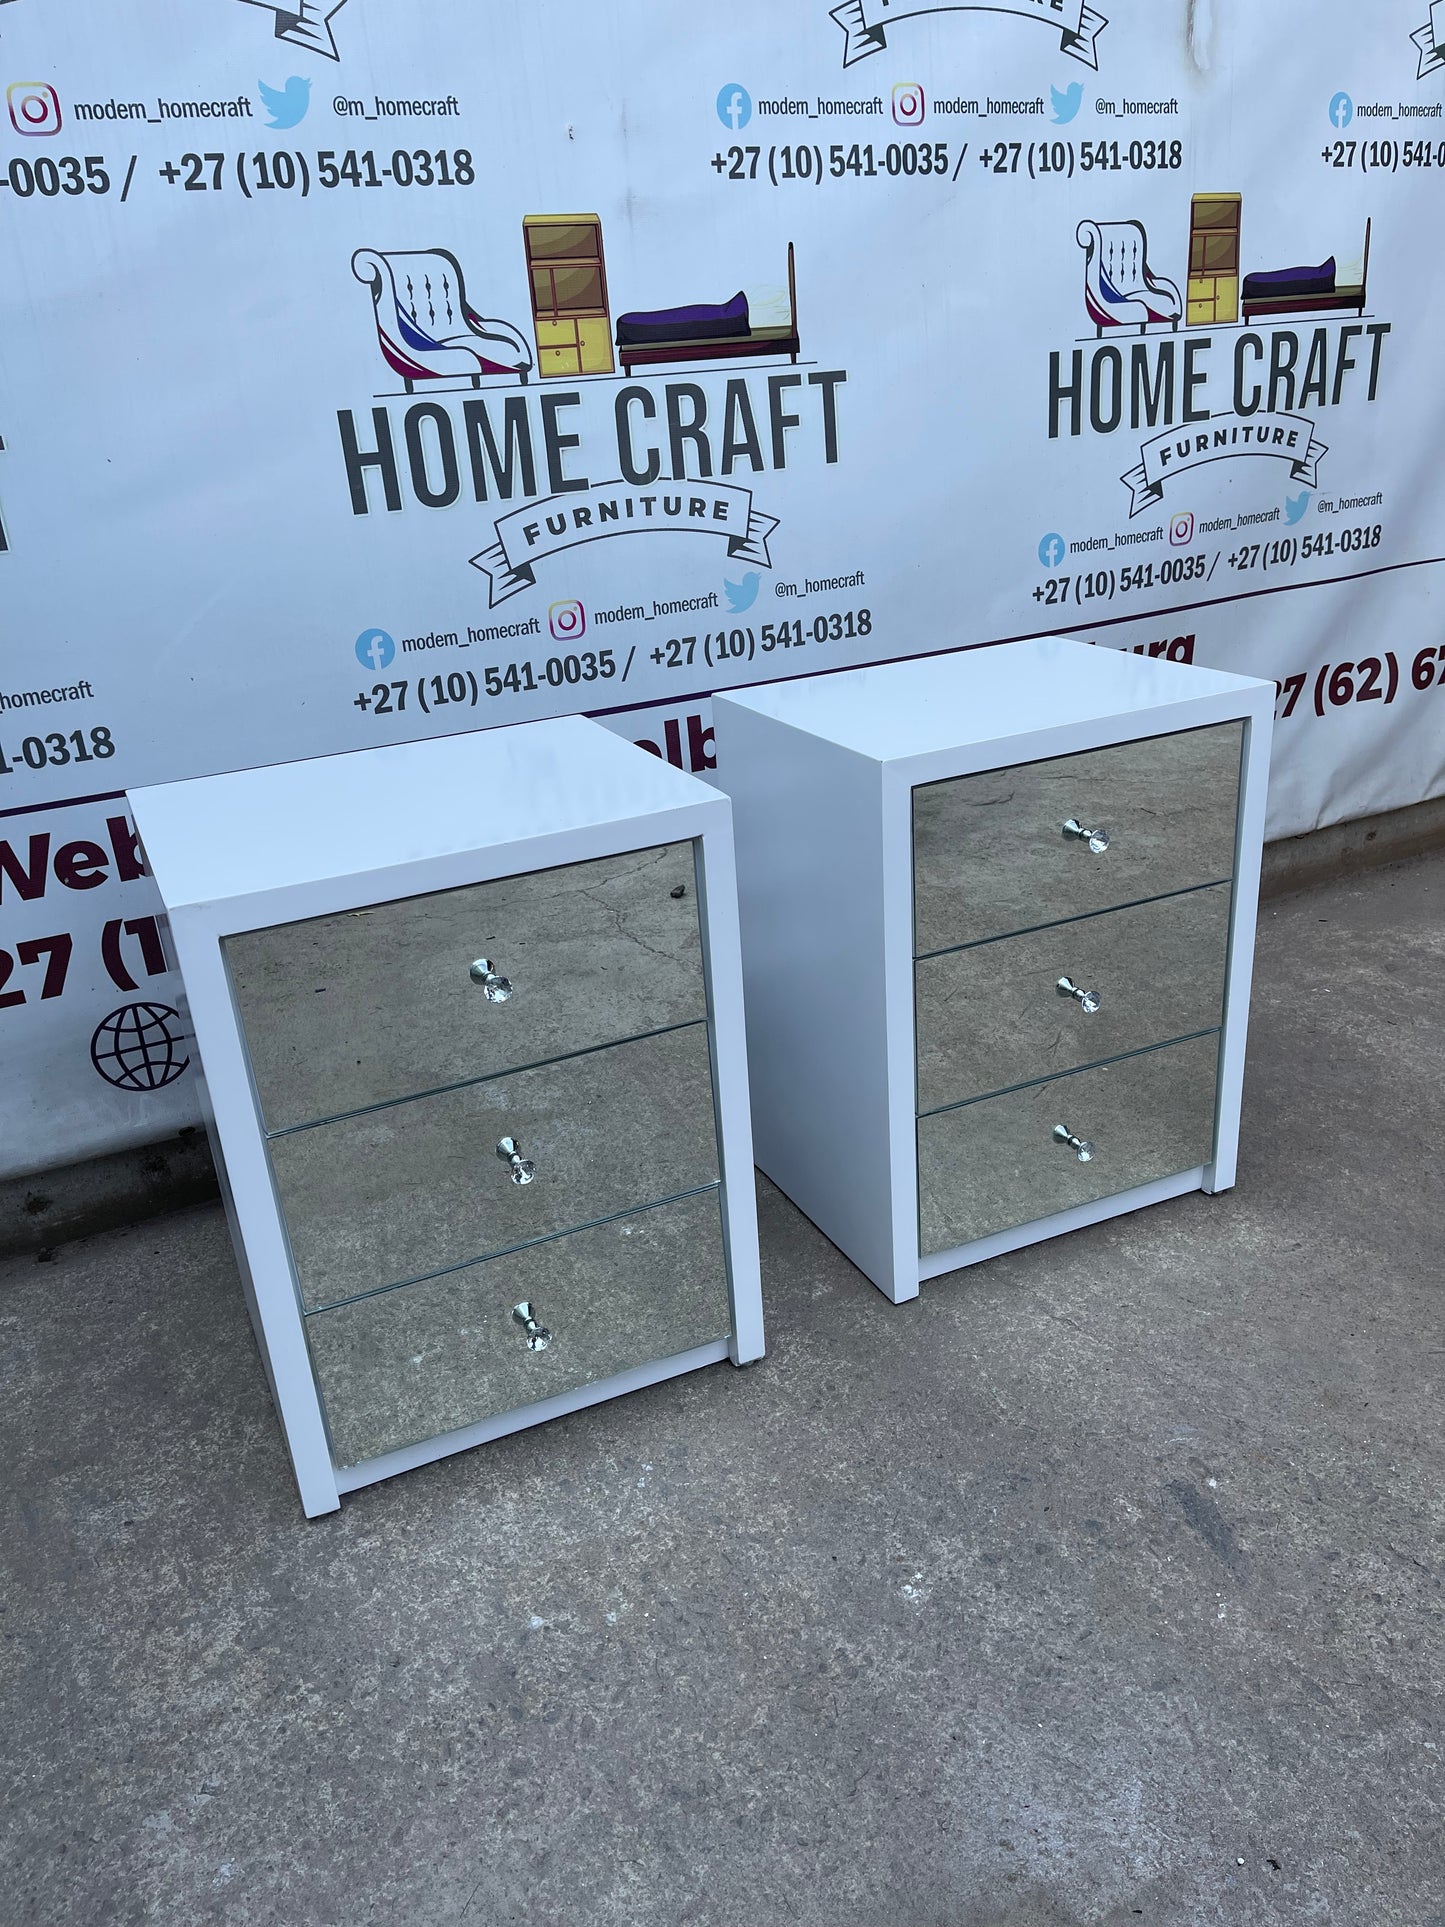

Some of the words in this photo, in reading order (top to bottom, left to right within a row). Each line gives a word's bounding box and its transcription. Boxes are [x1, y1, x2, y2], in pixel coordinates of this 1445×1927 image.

[333, 96, 460, 120] @m_homecraft
[1096, 98, 1178, 117] @m_homecraft
[159, 153, 224, 190] +27
[237, 151, 309, 198] (10)
[318, 149, 474, 188] 541-0318
[711, 146, 760, 179] +27
[769, 146, 822, 186] (10)
[830, 143, 948, 177] 541-0035
[980, 143, 1021, 173] +27
[1028, 142, 1074, 179] (10)
[1080, 140, 1182, 171] 541-0318
[1322, 141, 1356, 167] +27
[1362, 141, 1398, 173] (10)
[1049, 338, 1211, 438] HOME
[1234, 323, 1391, 417] CRAFT
[337, 392, 590, 515] HOME
[615, 370, 846, 485] CRAFT
[1160, 426, 1298, 466] FURNITURE
[523, 497, 728, 546] FURNITURE
[1318, 492, 1382, 513] @m_homecraft
[775, 571, 865, 597] @m_homecraft
[1033, 577, 1070, 605] +27
[1076, 570, 1115, 605] (10)
[1120, 554, 1205, 591] 541-0035
[1228, 544, 1260, 570] +27
[1263, 538, 1297, 570] (10)
[1301, 525, 1381, 558] 541-0318
[354, 681, 408, 714] +27
[418, 671, 478, 713] (10)
[485, 650, 615, 696] 541-0035
[650, 637, 696, 667] +27
[705, 628, 754, 667] (10)
[762, 609, 871, 651] 541-0318
[1314, 652, 1398, 716] (62)
